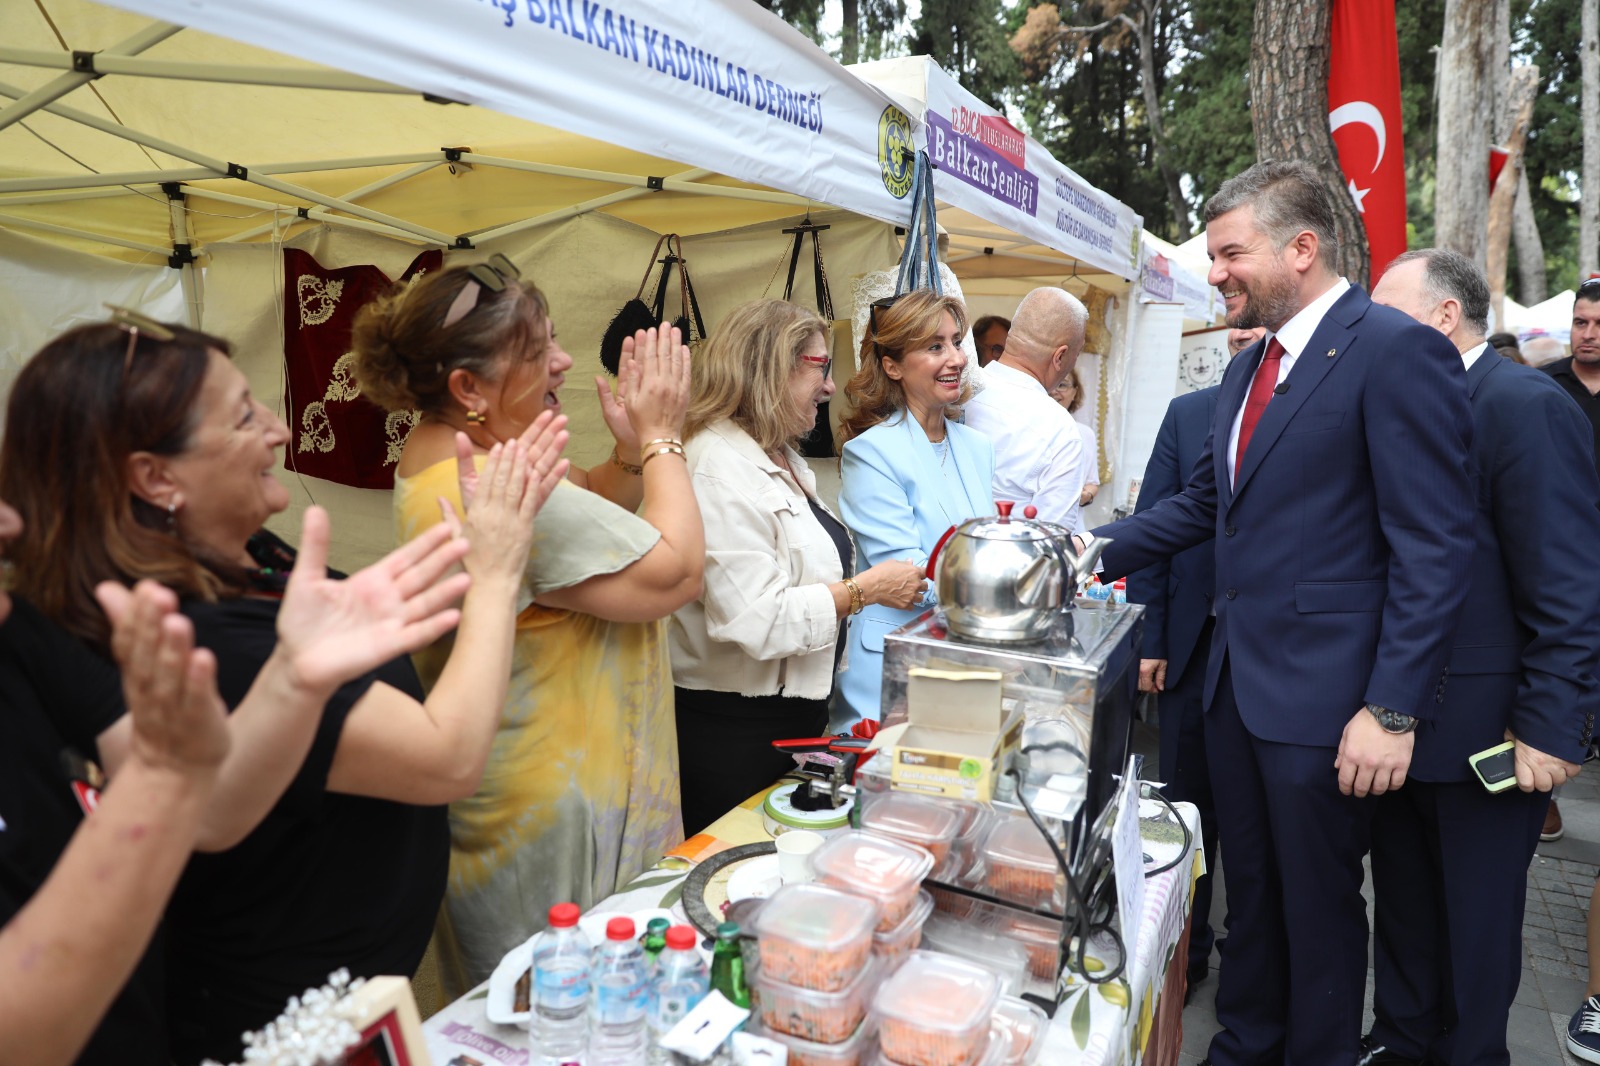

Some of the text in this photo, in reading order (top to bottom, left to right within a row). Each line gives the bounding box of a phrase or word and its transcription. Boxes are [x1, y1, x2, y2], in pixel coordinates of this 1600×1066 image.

[528, 0, 639, 63] BALKAN
[643, 25, 751, 107] KADINLAR
[753, 73, 823, 135] DERNEĞİ
[885, 108, 907, 131] BUCA
[959, 105, 982, 139] BUCA
[983, 124, 1024, 158] ULUSLARARASI
[458, 1031, 494, 1053] Olive
